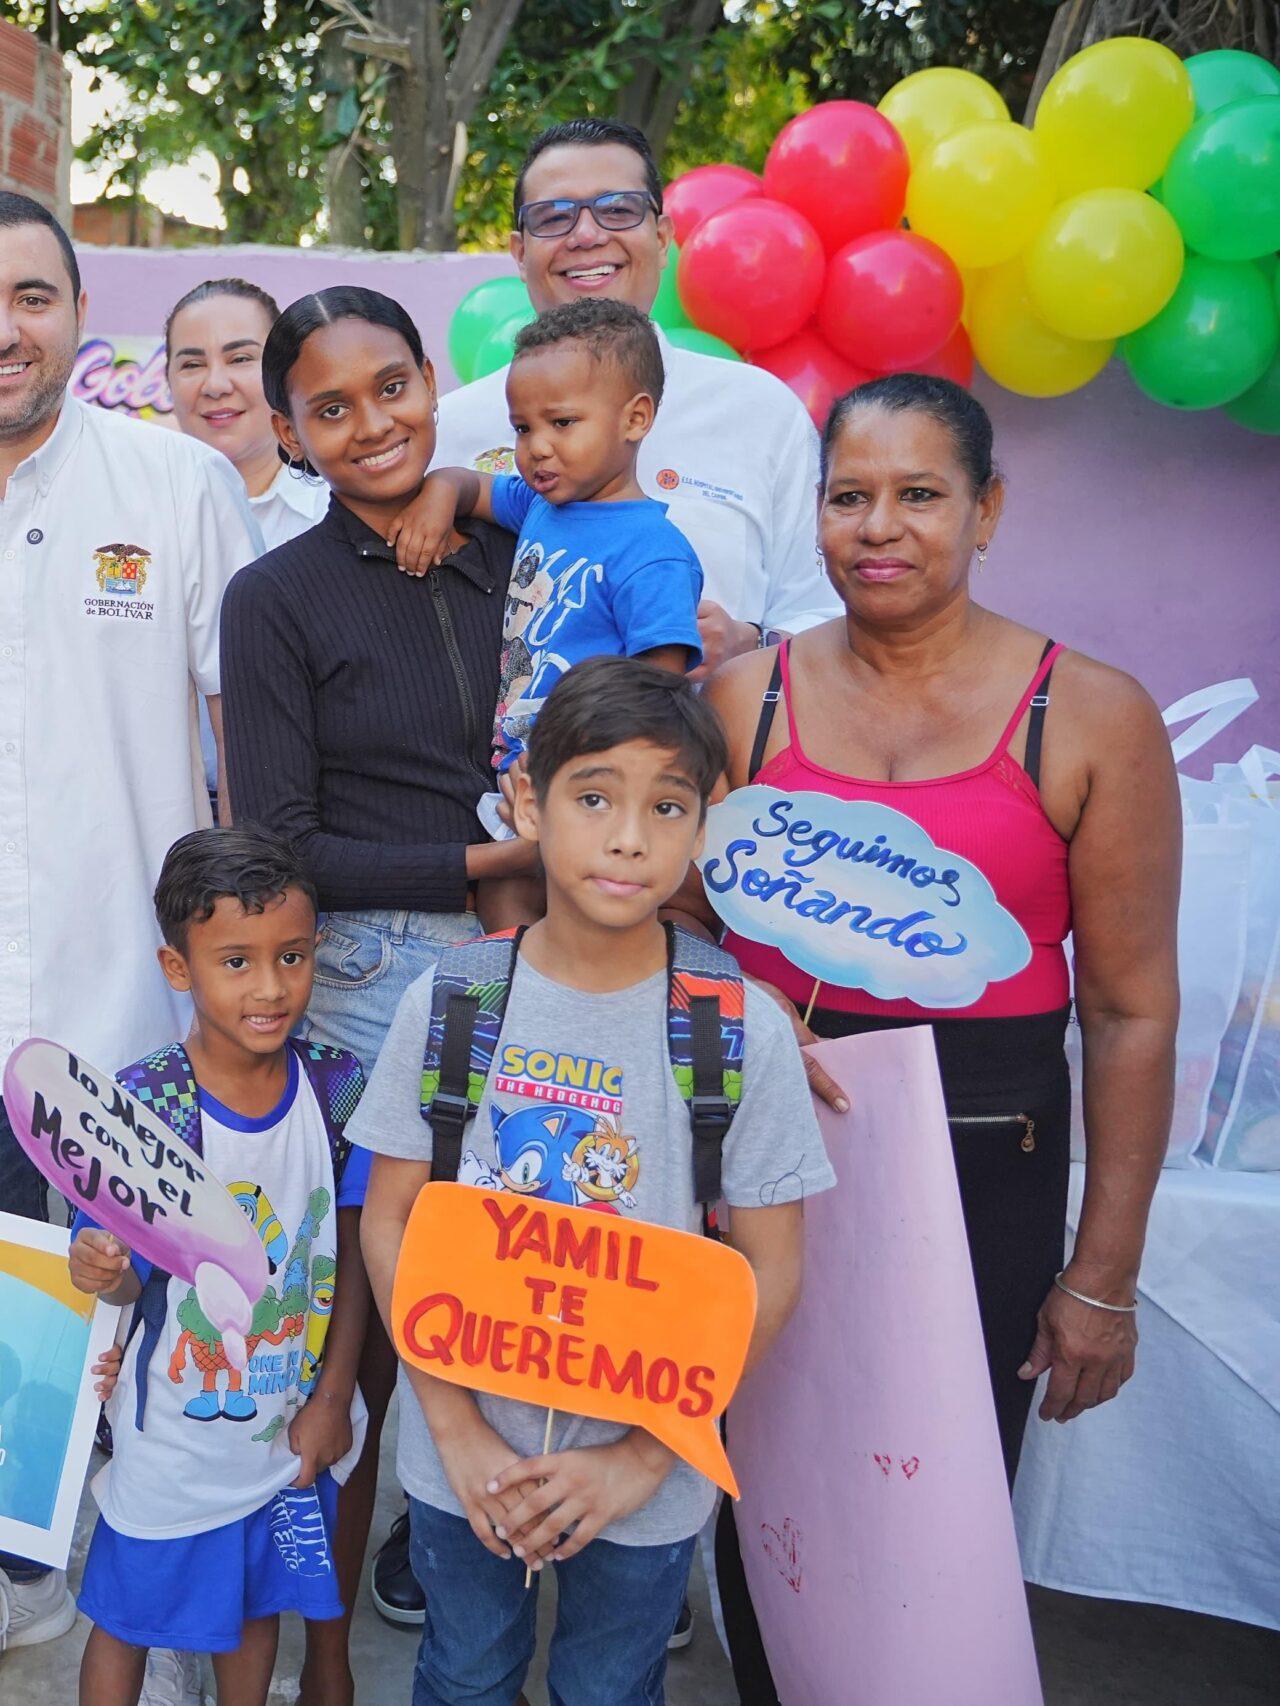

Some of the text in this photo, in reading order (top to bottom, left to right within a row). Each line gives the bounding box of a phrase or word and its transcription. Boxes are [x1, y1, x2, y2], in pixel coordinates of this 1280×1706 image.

[84, 598, 154, 612] GOBERNACIÓN
[86, 607, 154, 621] de BOLÍVAR
[752, 800, 961, 907] Seguimos
[703, 838, 968, 957] Soñando
[497, 1078, 622, 1114] THE HEDGEHOG
[500, 1044, 623, 1097] SONIC
[482, 1197, 660, 1292] YAMIL
[524, 1275, 588, 1327] TE
[248, 1354, 284, 1373] ONE
[403, 1292, 716, 1418] QUEREMOS
